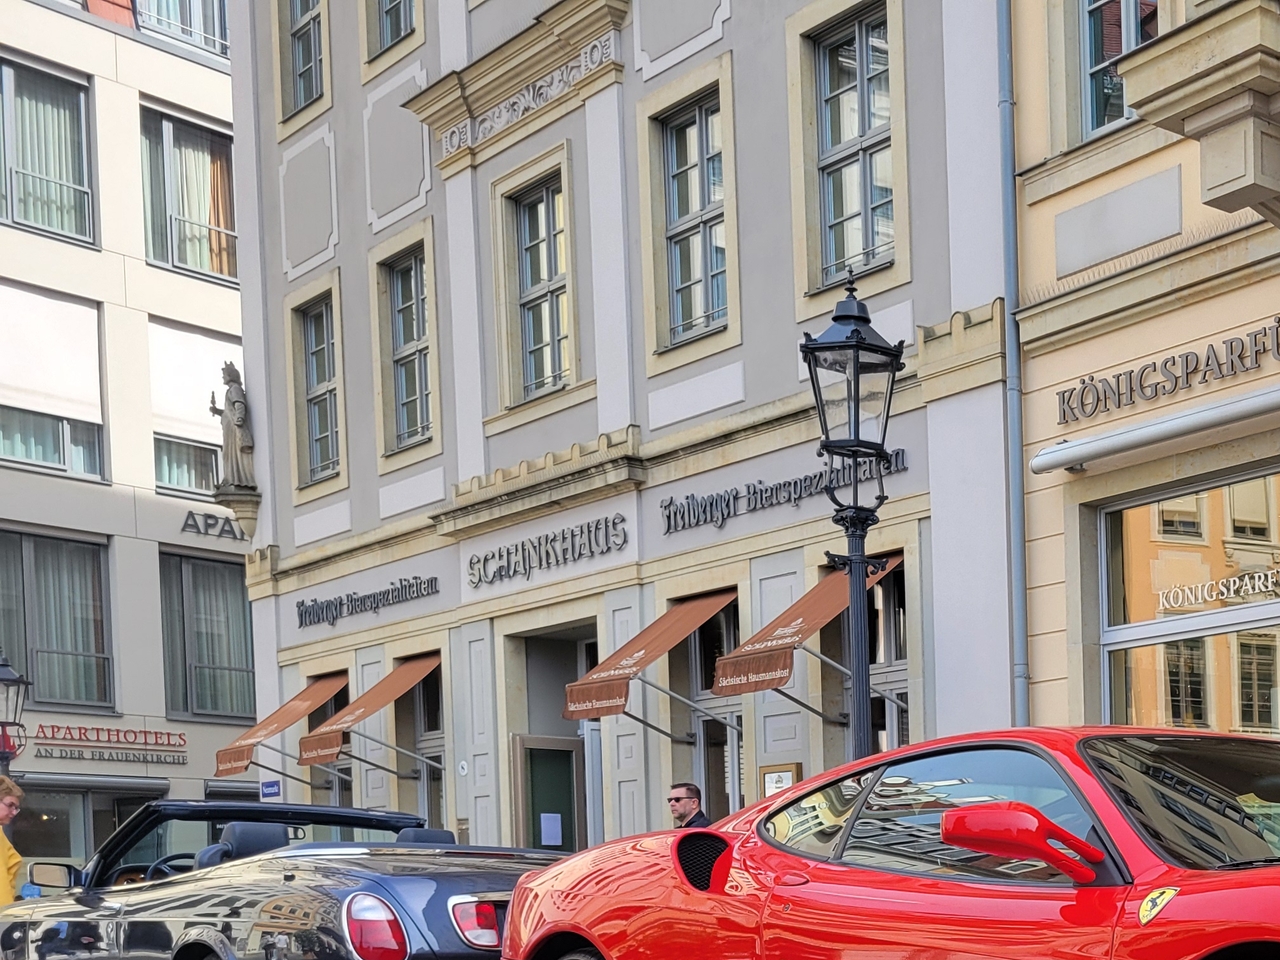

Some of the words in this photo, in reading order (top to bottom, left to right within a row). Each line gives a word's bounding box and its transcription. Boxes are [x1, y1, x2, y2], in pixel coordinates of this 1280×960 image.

[181, 510, 246, 541] APA
[659, 487, 739, 536] Freiberger
[467, 512, 630, 589] SCHANKHAUS
[35, 723, 187, 747] APARTHOTELS
[34, 747, 54, 758] AN
[59, 748, 84, 759] DER
[91, 750, 188, 765] FRAUENKIRCHE
